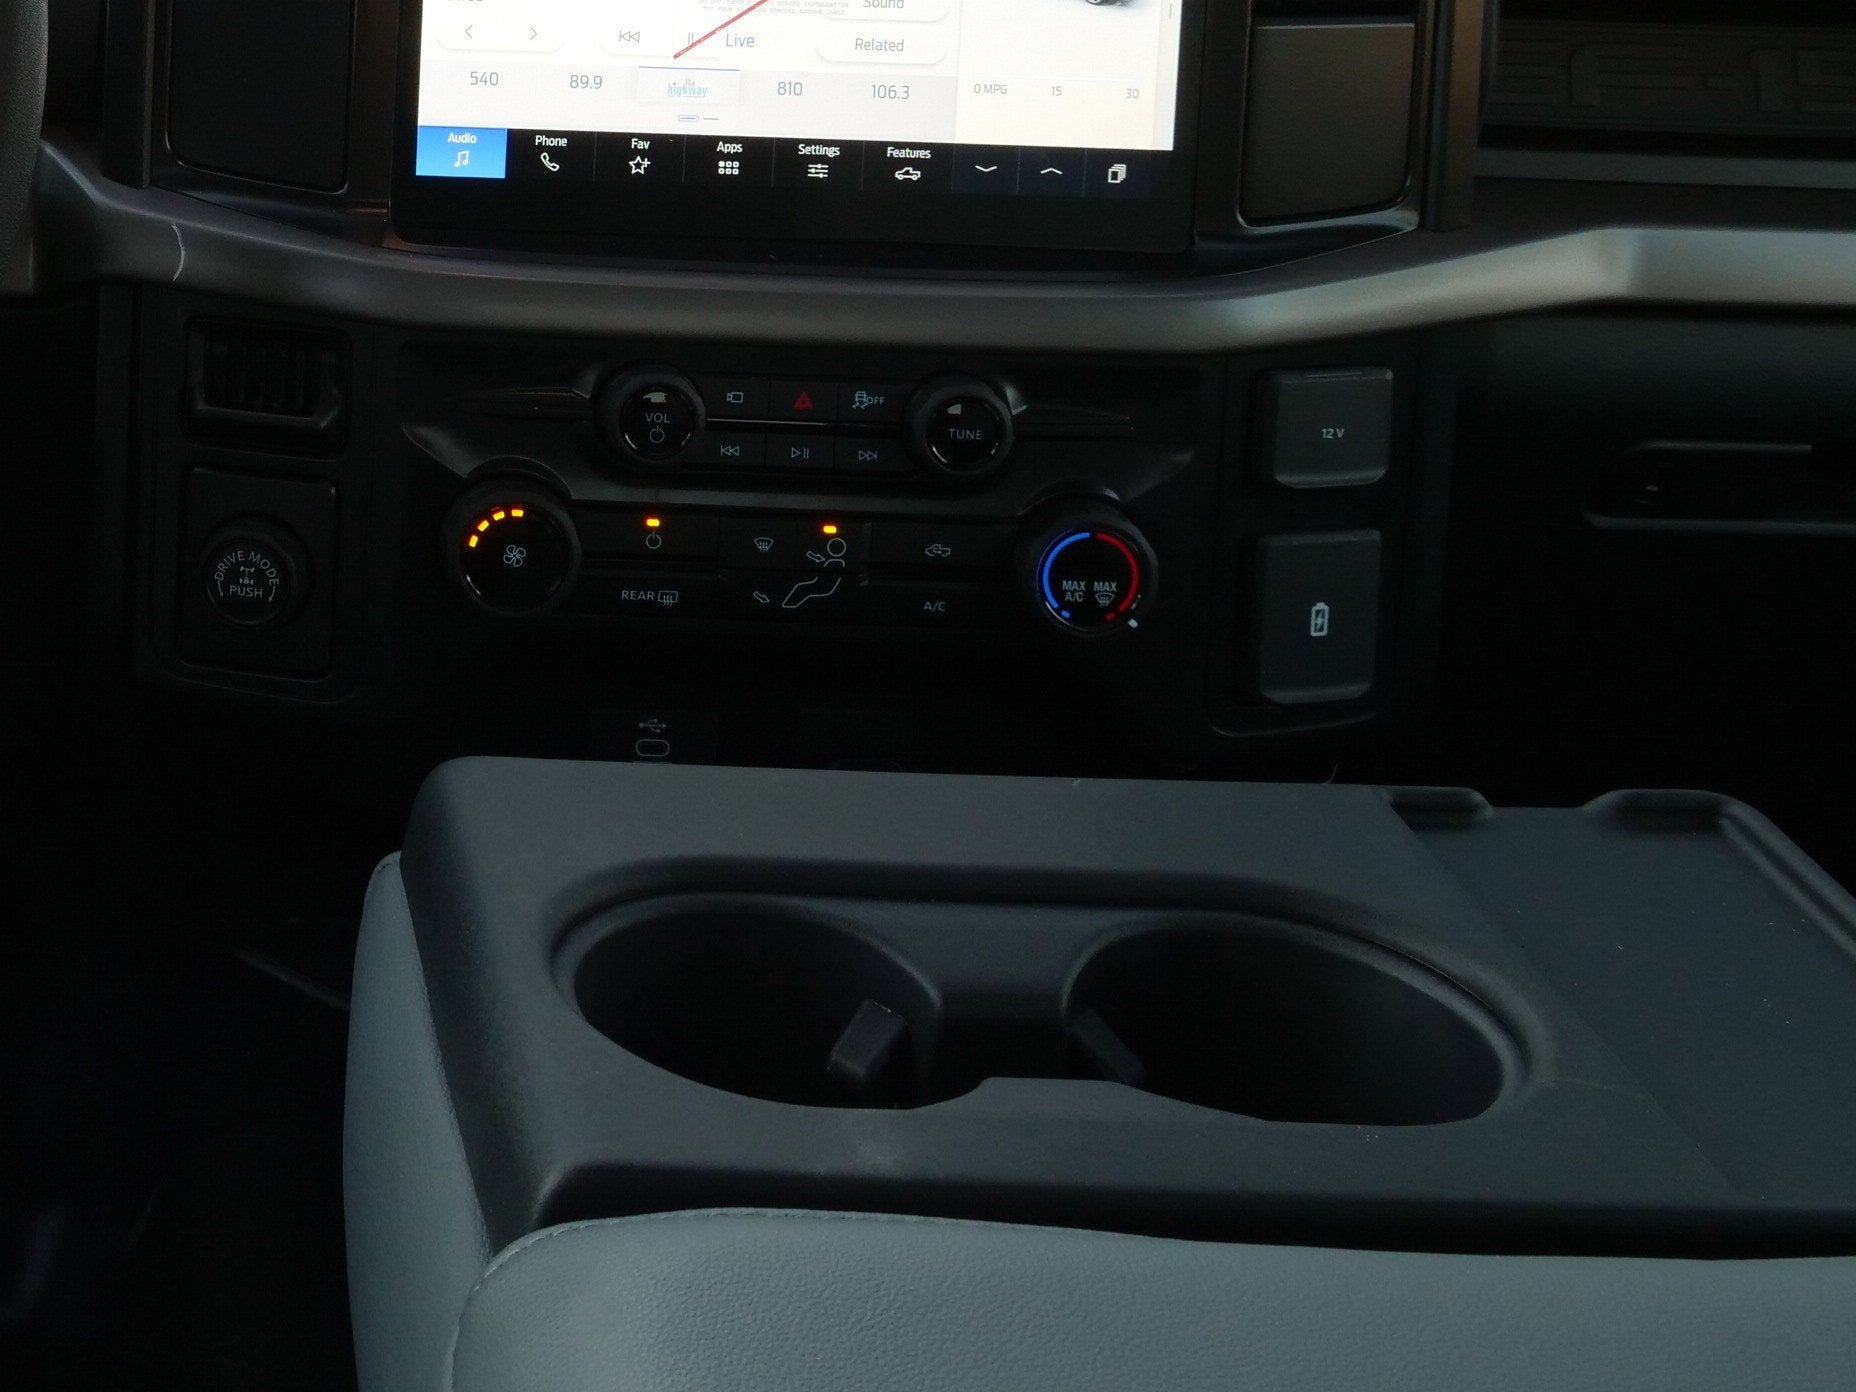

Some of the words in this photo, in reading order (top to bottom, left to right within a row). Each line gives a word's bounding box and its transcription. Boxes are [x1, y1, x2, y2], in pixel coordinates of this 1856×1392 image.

[726, 33, 755, 47] Live
[854, 38, 904, 52] Related
[470, 72, 499, 86] 540
[569, 75, 603, 90] 89.9
[668, 83, 708, 98] highway
[777, 81, 803, 96] 810
[871, 84, 910, 100] 106.3
[974, 84, 981, 94] 0
[983, 84, 1008, 95] MPG
[1051, 86, 1062, 96] 15
[1125, 88, 1139, 99] 30
[448, 133, 477, 144] Audio
[535, 135, 568, 146] Phone
[631, 138, 650, 149] Fav
[717, 141, 743, 154] Apps
[798, 144, 840, 157] Settings
[887, 147, 931, 159] Features
[867, 396, 885, 405] OFF
[645, 412, 670, 423] VOL
[948, 428, 983, 440] TUNE
[214, 550, 245, 581] DRIVE
[248, 551, 280, 586] MODE
[229, 584, 263, 598] PUSH
[1062, 580, 1086, 591] MAX
[1093, 581, 1118, 592] MAX
[621, 590, 655, 601] REAR
[1065, 592, 1084, 603] A/C
[923, 601, 946, 612] A/C
